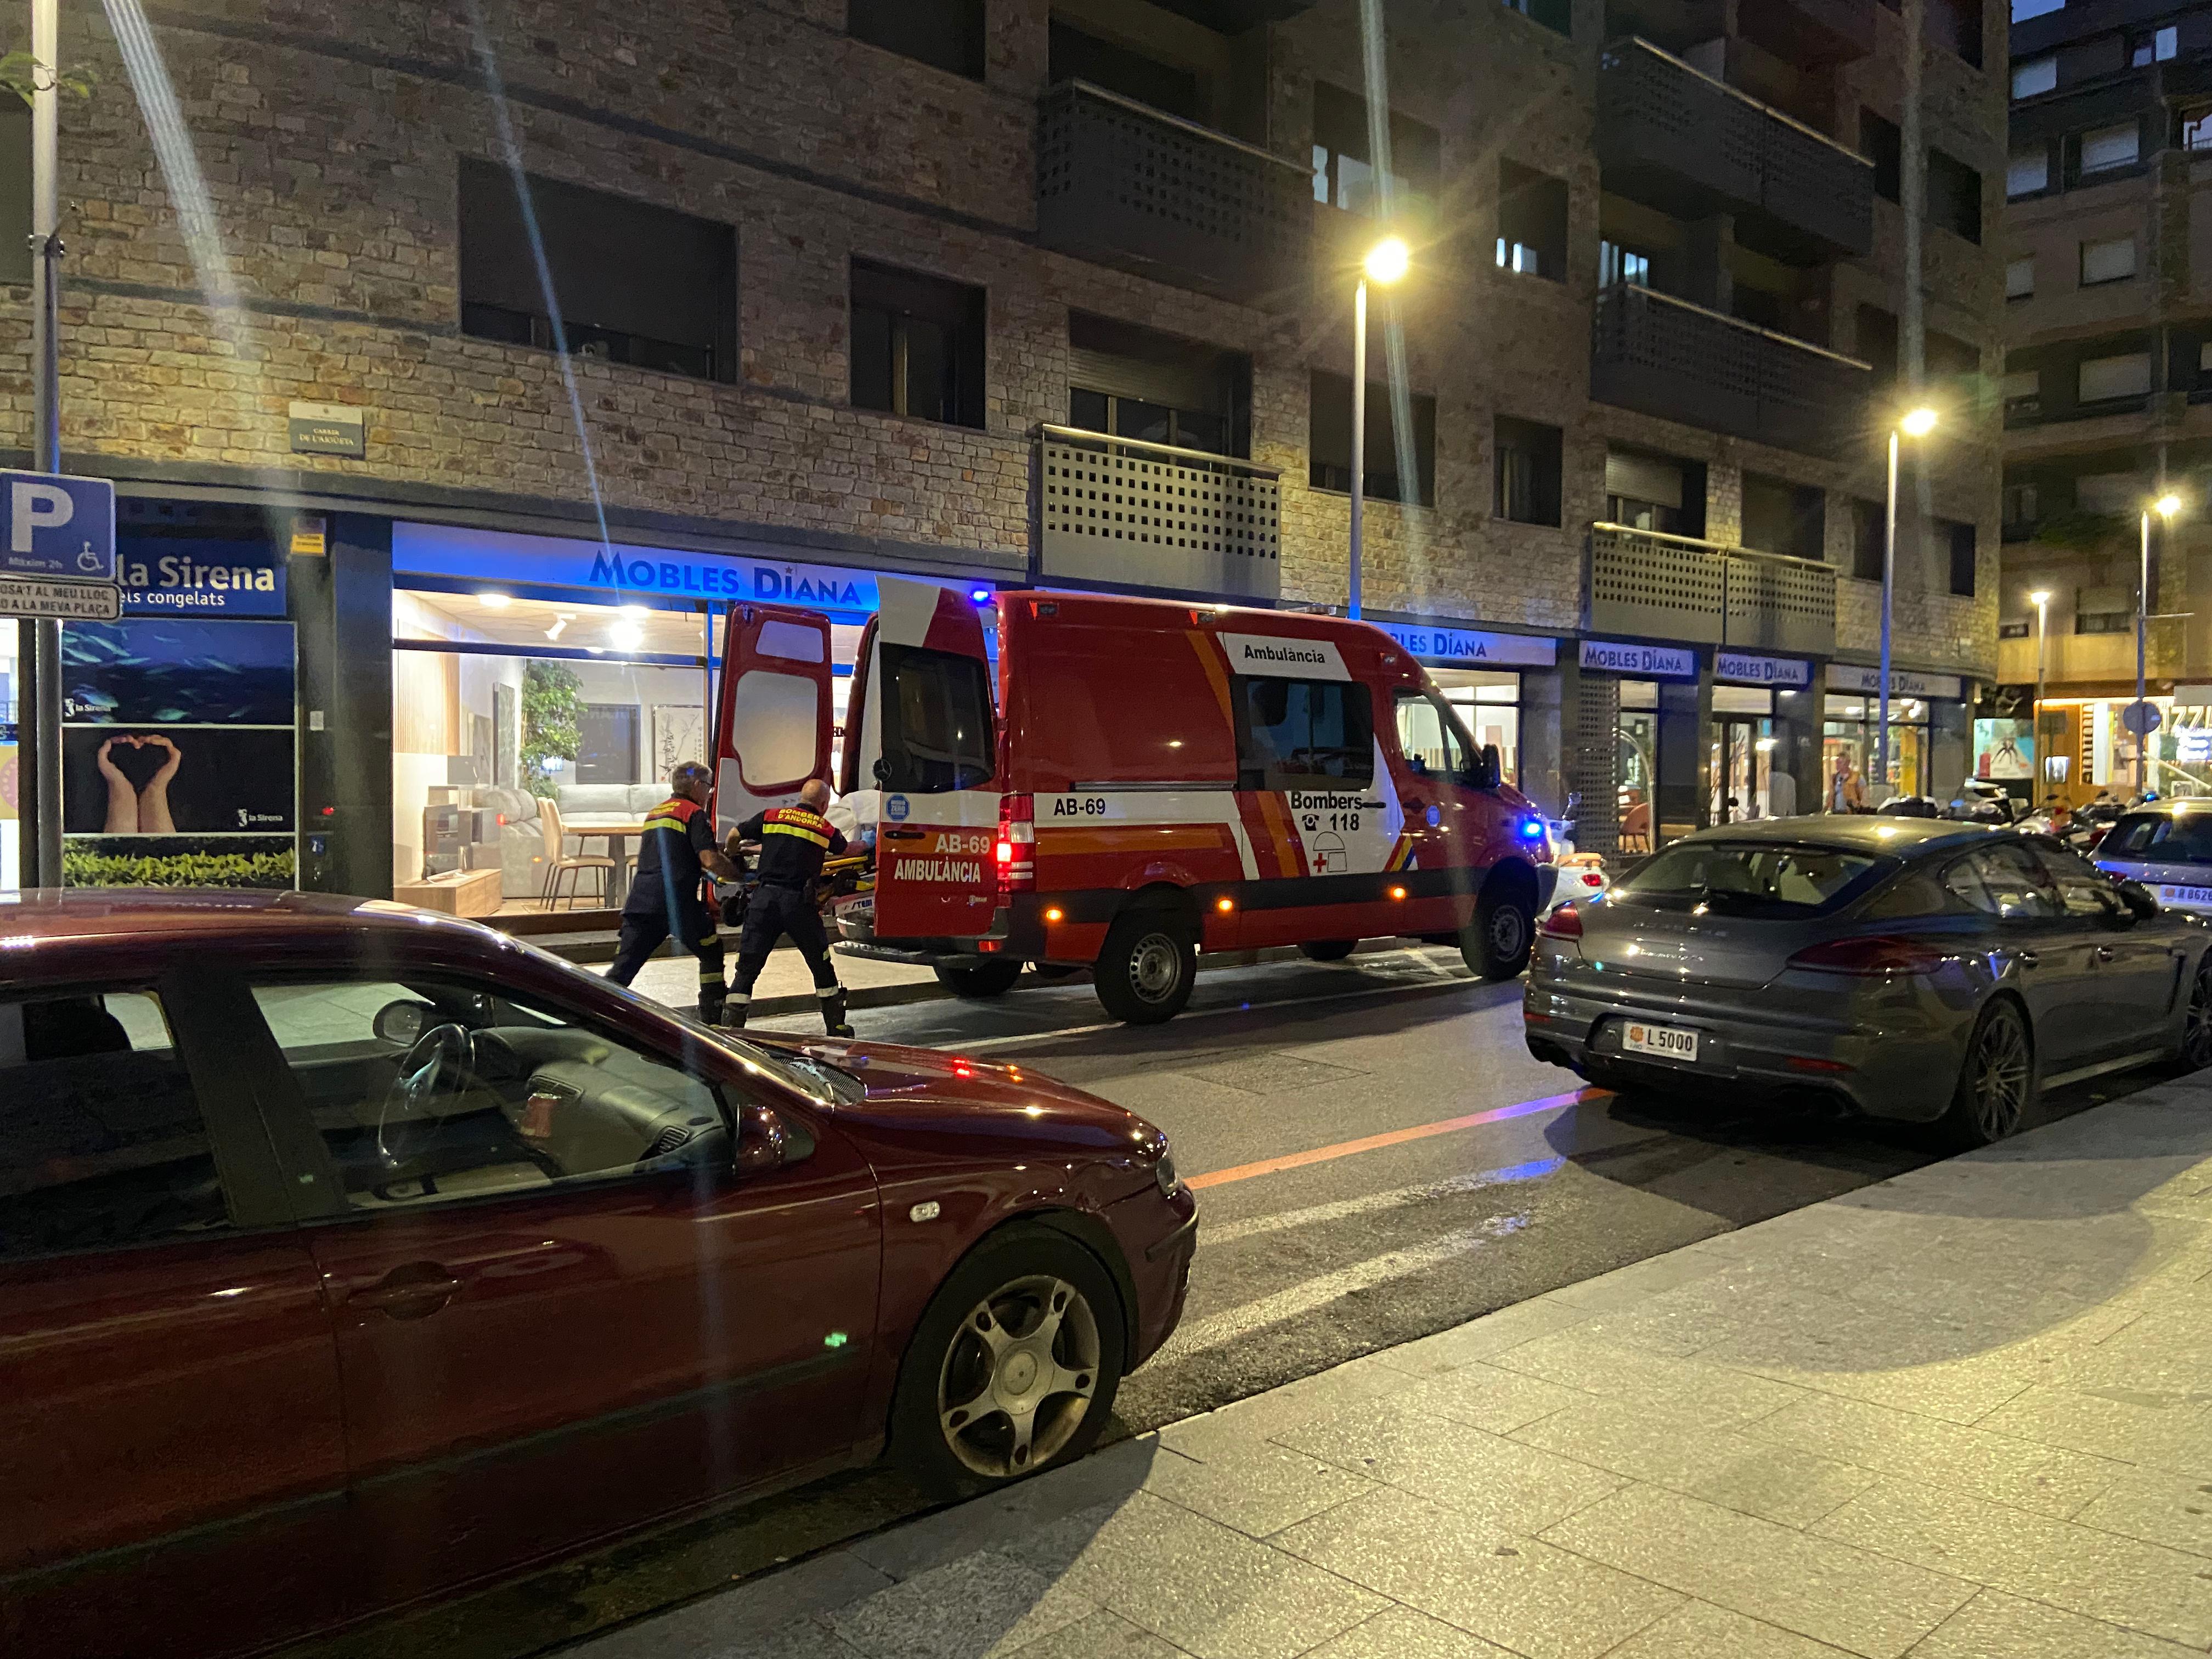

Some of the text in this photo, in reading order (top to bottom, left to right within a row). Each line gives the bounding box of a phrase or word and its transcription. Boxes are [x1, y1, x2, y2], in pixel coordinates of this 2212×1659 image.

[11, 482, 74, 553] P
[116, 554, 275, 592] la Sirena
[589, 549, 739, 594] MOBLES
[36, 586, 49, 597] AL
[53, 587, 78, 599] MEU
[80, 589, 109, 600] LLOC
[147, 591, 225, 608] congelats
[12, 599, 20, 610] A
[22, 600, 37, 610] LA
[40, 601, 71, 612] MEVA
[74, 602, 110, 617] PLAÇA
[1585, 646, 1638, 668] MOBLES
[1053, 798, 1106, 816] AB-69
[1291, 791, 1363, 810] Bombers
[777, 814, 823, 829] D'ANDORRA
[778, 808, 825, 824] BOMBERS
[1330, 813, 1359, 831] 118
[934, 833, 991, 854] AB-69
[1647, 1029, 1655, 1046] L
